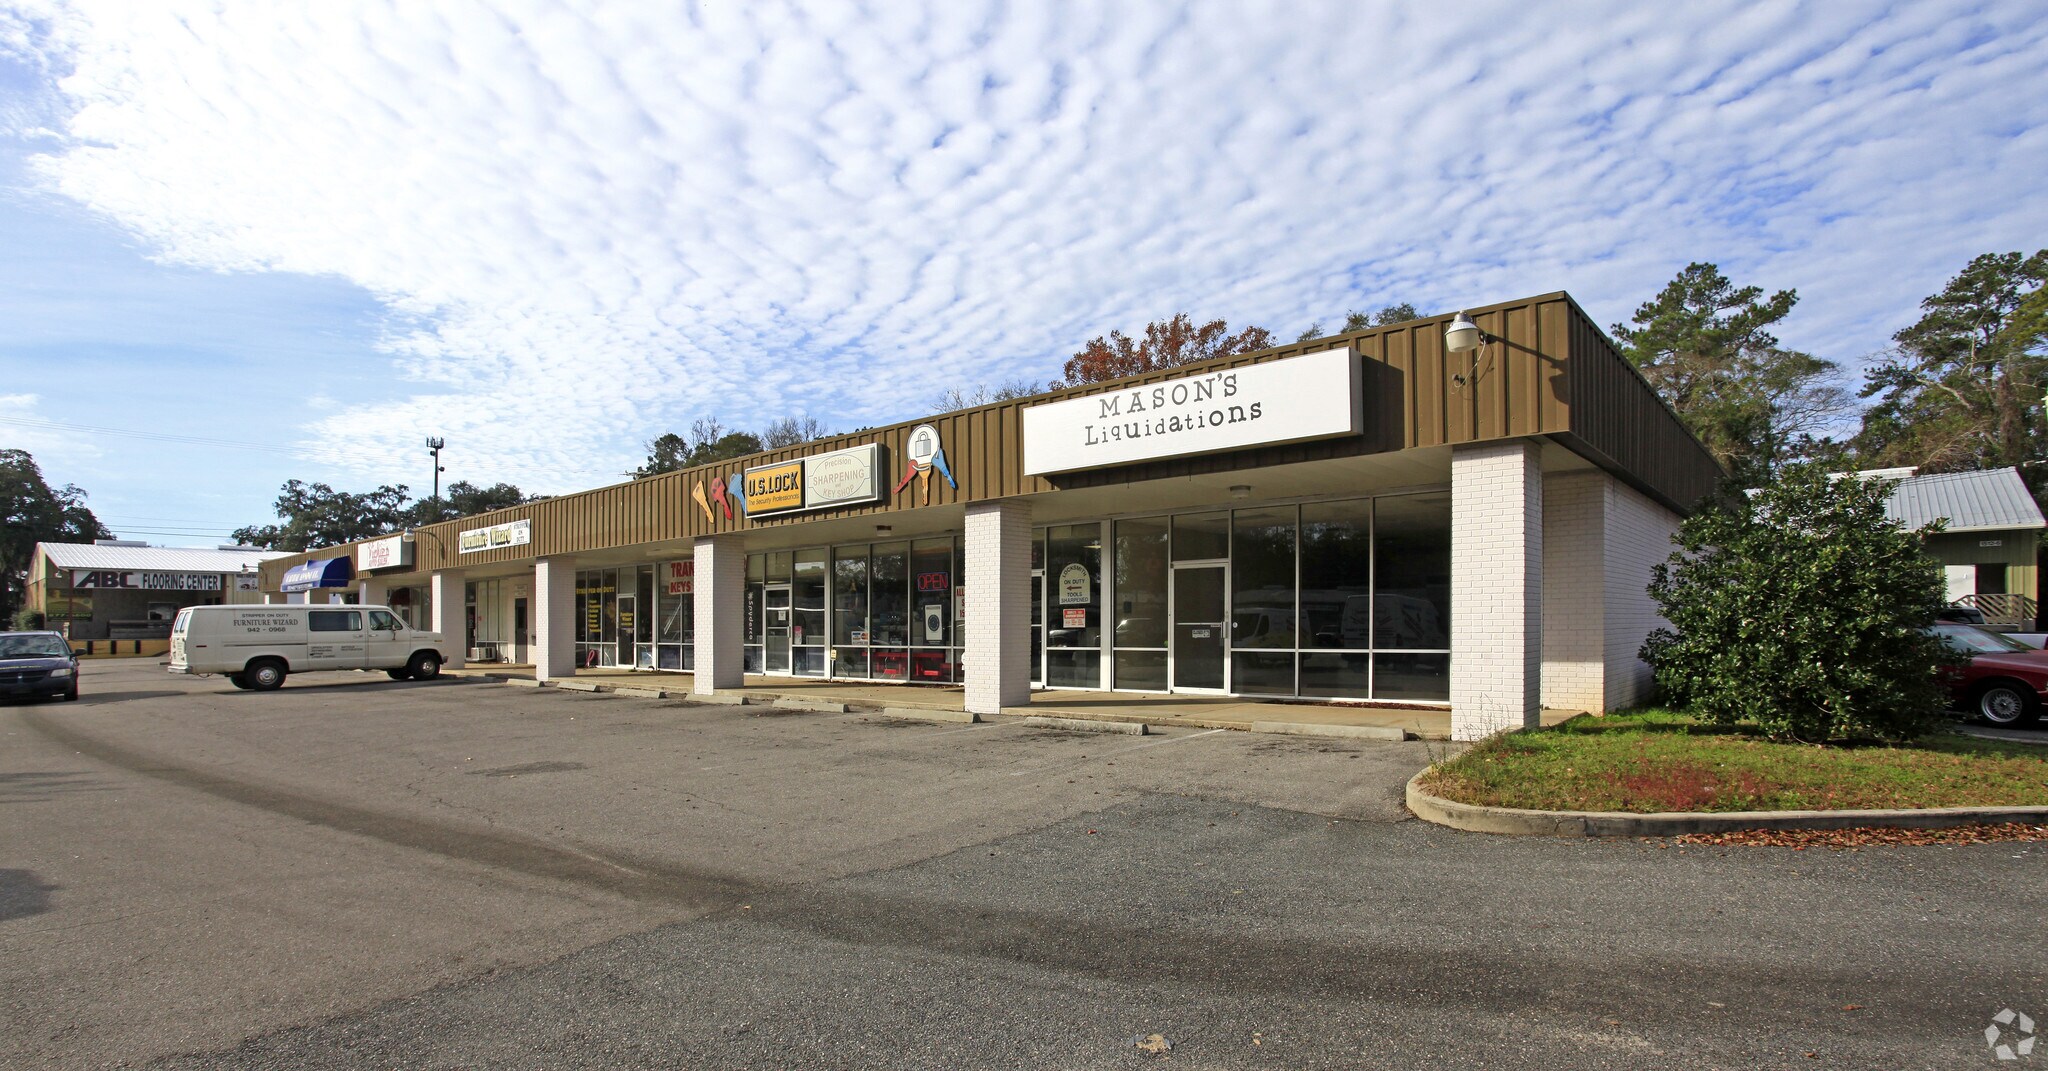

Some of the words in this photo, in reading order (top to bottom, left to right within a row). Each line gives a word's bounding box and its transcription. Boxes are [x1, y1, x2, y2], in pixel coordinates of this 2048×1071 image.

[1099, 373, 1238, 419] MASON'S
[1084, 401, 1263, 446] Liquidations
[824, 457, 852, 470] Precision
[813, 469, 865, 486] SHARPENING
[755, 496, 772, 505] Security
[772, 493, 799, 502] Professionals
[822, 488, 837, 498] KEY
[837, 485, 855, 497] SHOP
[461, 531, 488, 551] Furniture
[490, 525, 512, 546] Wizard
[1062, 565, 1087, 578] LOCKSMITH
[74, 571, 139, 588] ABC
[142, 572, 184, 590] FLOORING
[186, 574, 218, 591] CENTER
[670, 581, 691, 593] KEYS
[918, 573, 948, 590] OPEN
